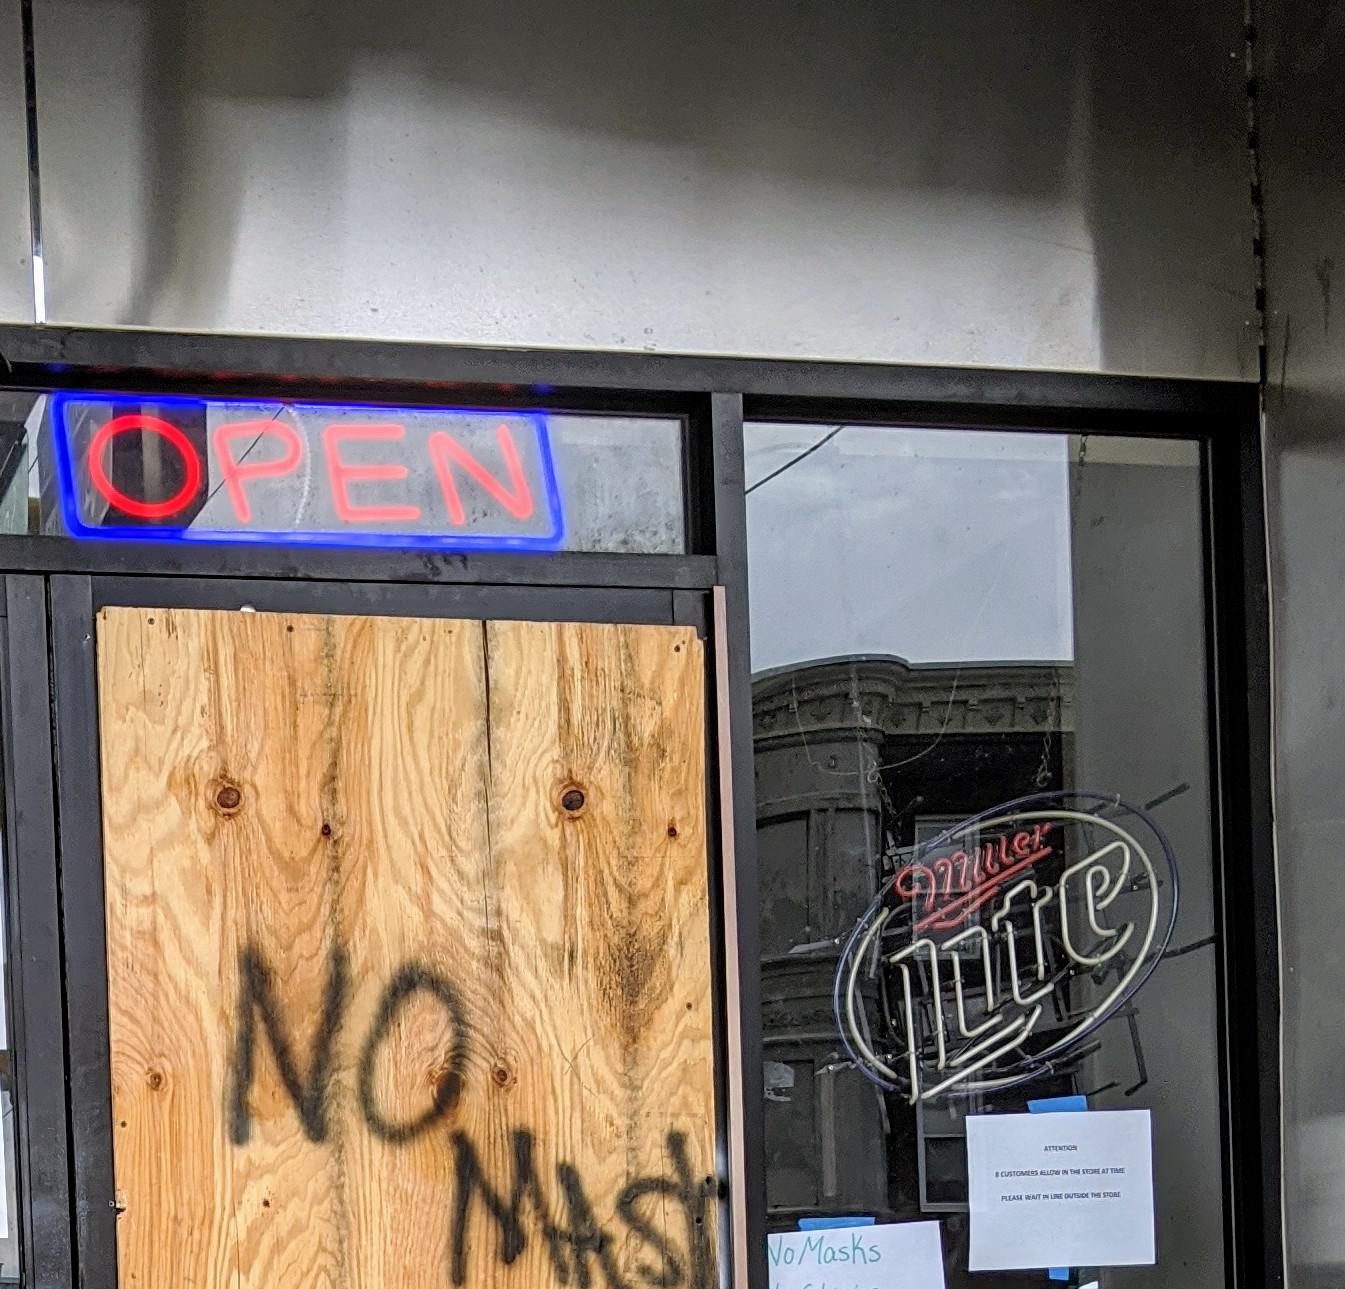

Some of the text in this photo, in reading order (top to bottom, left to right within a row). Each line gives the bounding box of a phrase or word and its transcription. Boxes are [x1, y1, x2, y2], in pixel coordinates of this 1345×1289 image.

[87, 413, 536, 526] OPEN
[894, 822, 1053, 912] Miller
[888, 840, 1134, 1105] Lite
[798, 1232, 882, 1265] Masks
